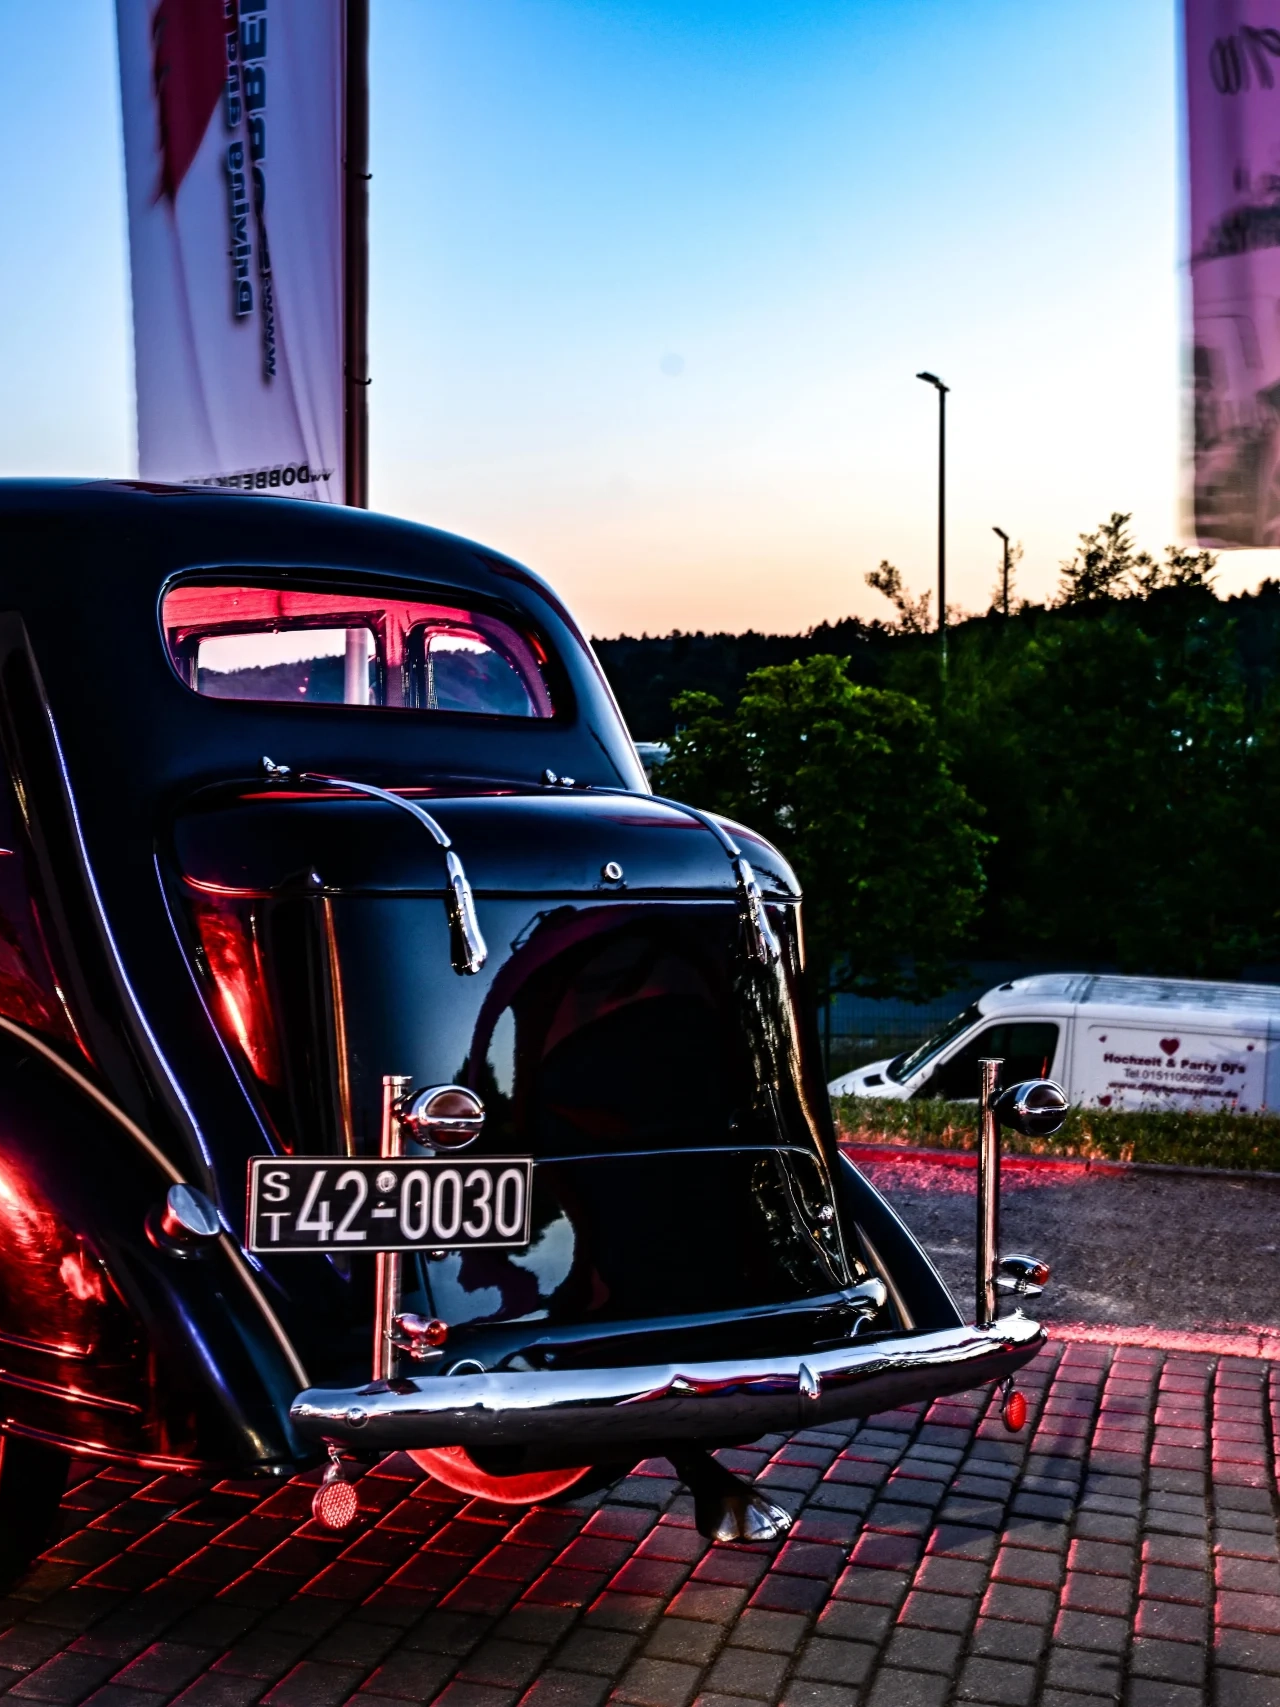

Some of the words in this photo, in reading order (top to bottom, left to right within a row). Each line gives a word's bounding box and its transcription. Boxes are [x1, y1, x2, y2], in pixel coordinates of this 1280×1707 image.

[1103, 1053, 1162, 1068] Hochzeit
[1166, 1058, 1176, 1069] &
[1180, 1058, 1217, 1074] Party
[295, 1168, 525, 1241] 42-0030
